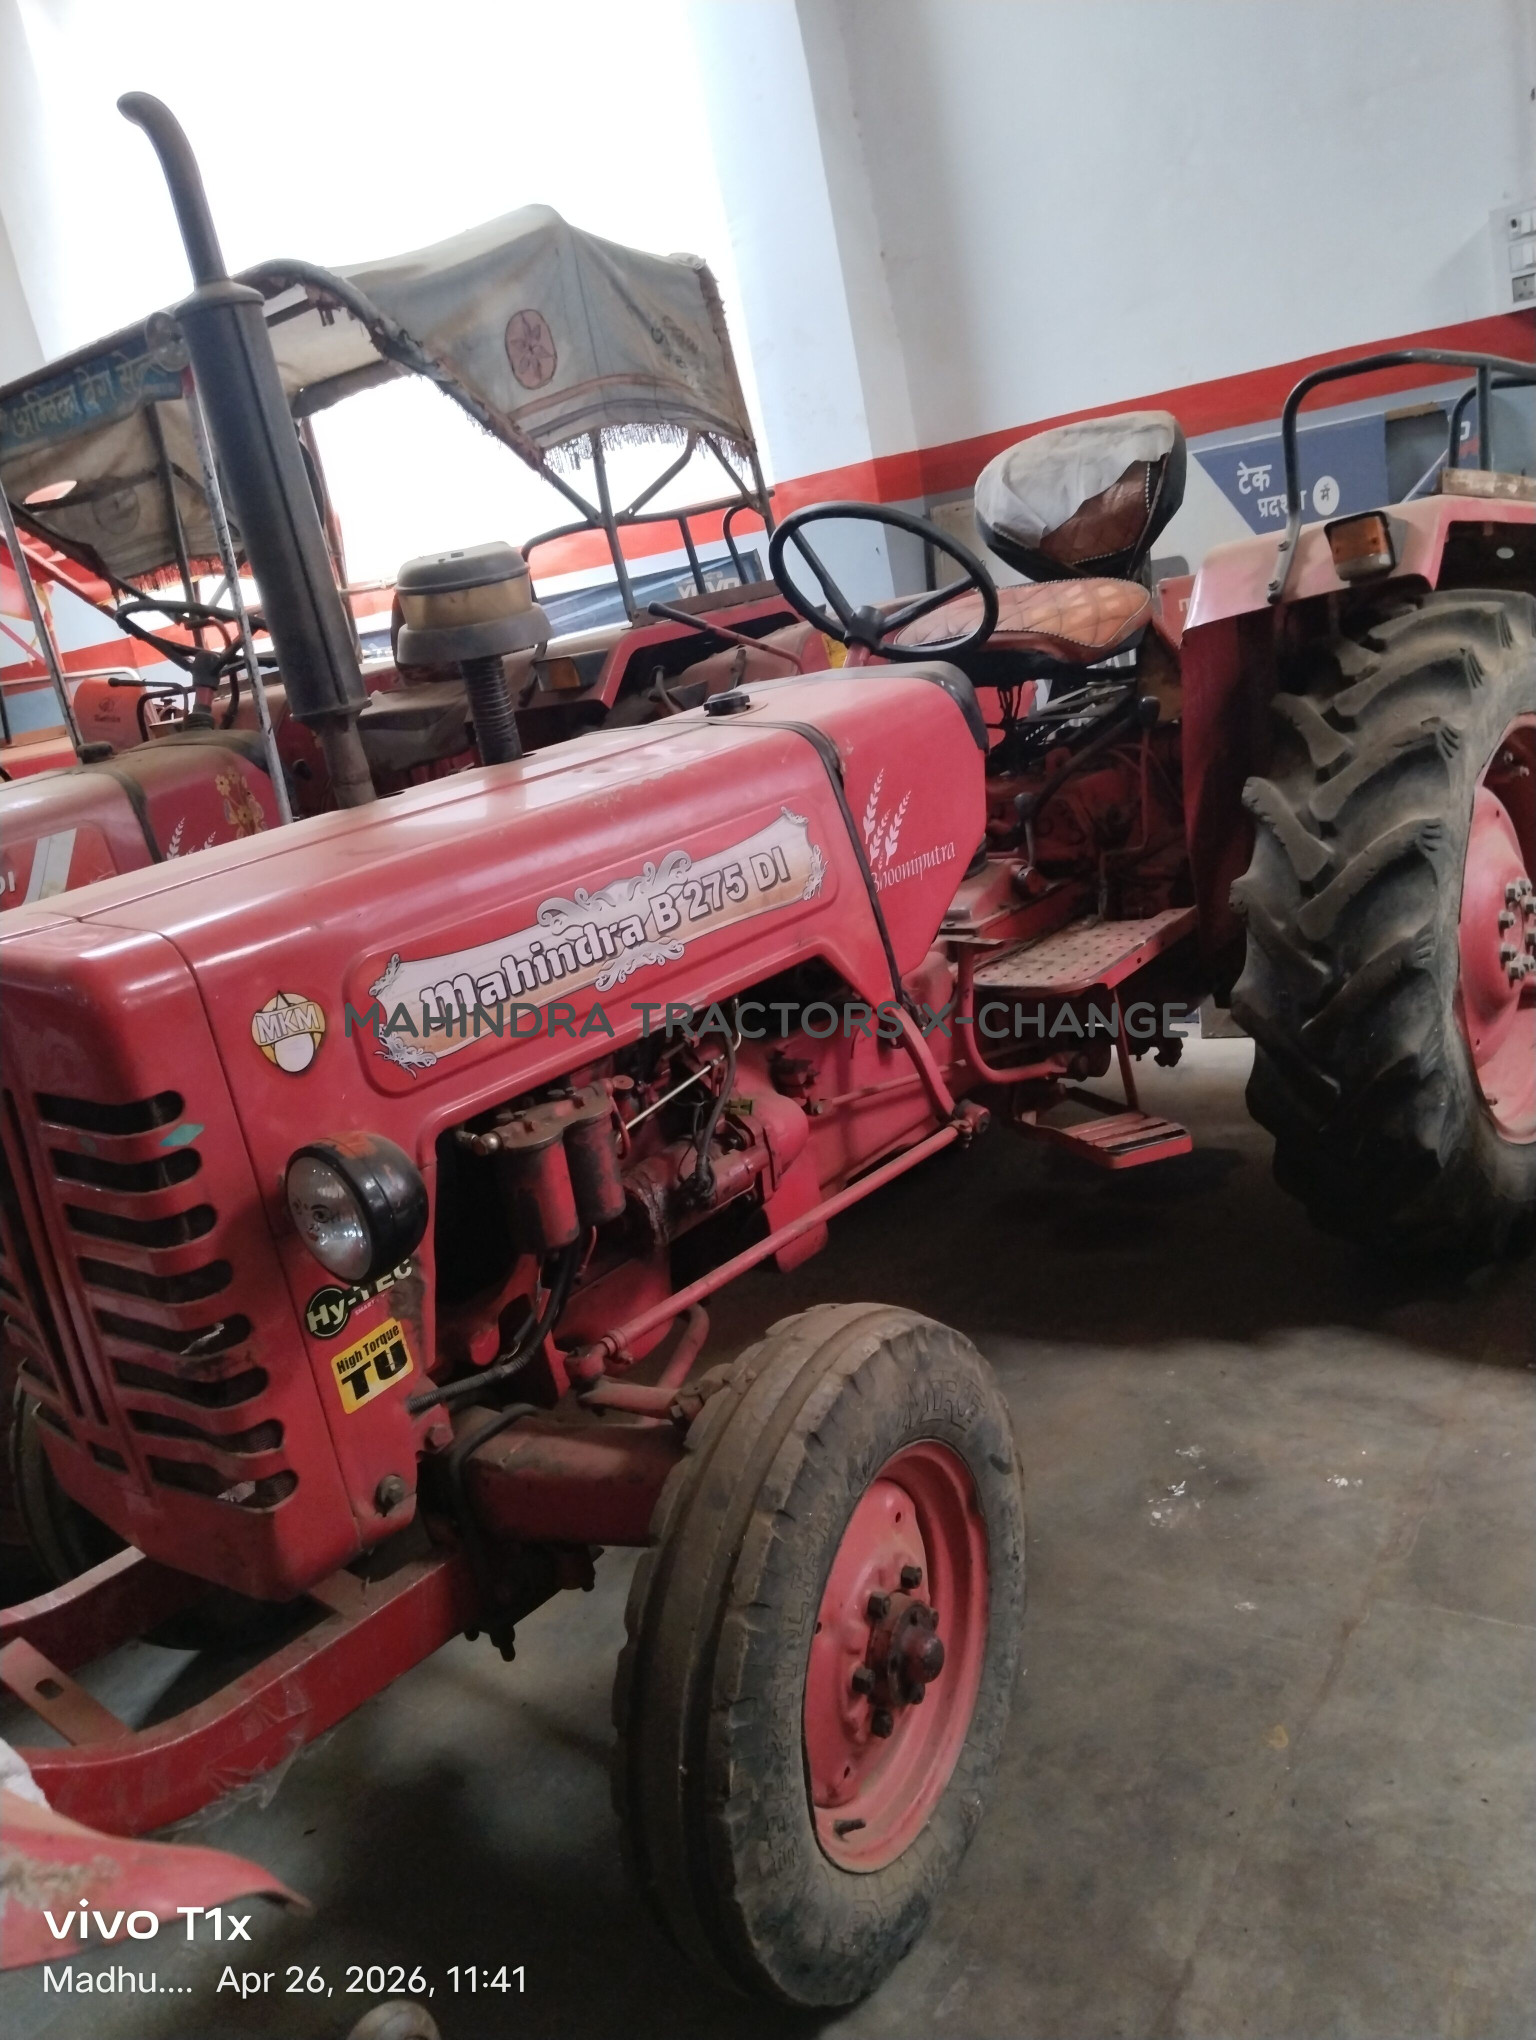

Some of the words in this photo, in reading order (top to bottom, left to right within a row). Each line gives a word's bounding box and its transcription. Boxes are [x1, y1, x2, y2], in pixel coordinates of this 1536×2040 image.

[1236, 461, 1273, 495] टेक
[419, 914, 646, 1030] Mahindra
[648, 889, 682, 935] B
[684, 865, 749, 922] 275
[750, 845, 793, 893] DI
[255, 1003, 321, 1044] MKM
[336, 1349, 364, 1375] High
[362, 1324, 401, 1356] Torque
[341, 1339, 409, 1401] TU
